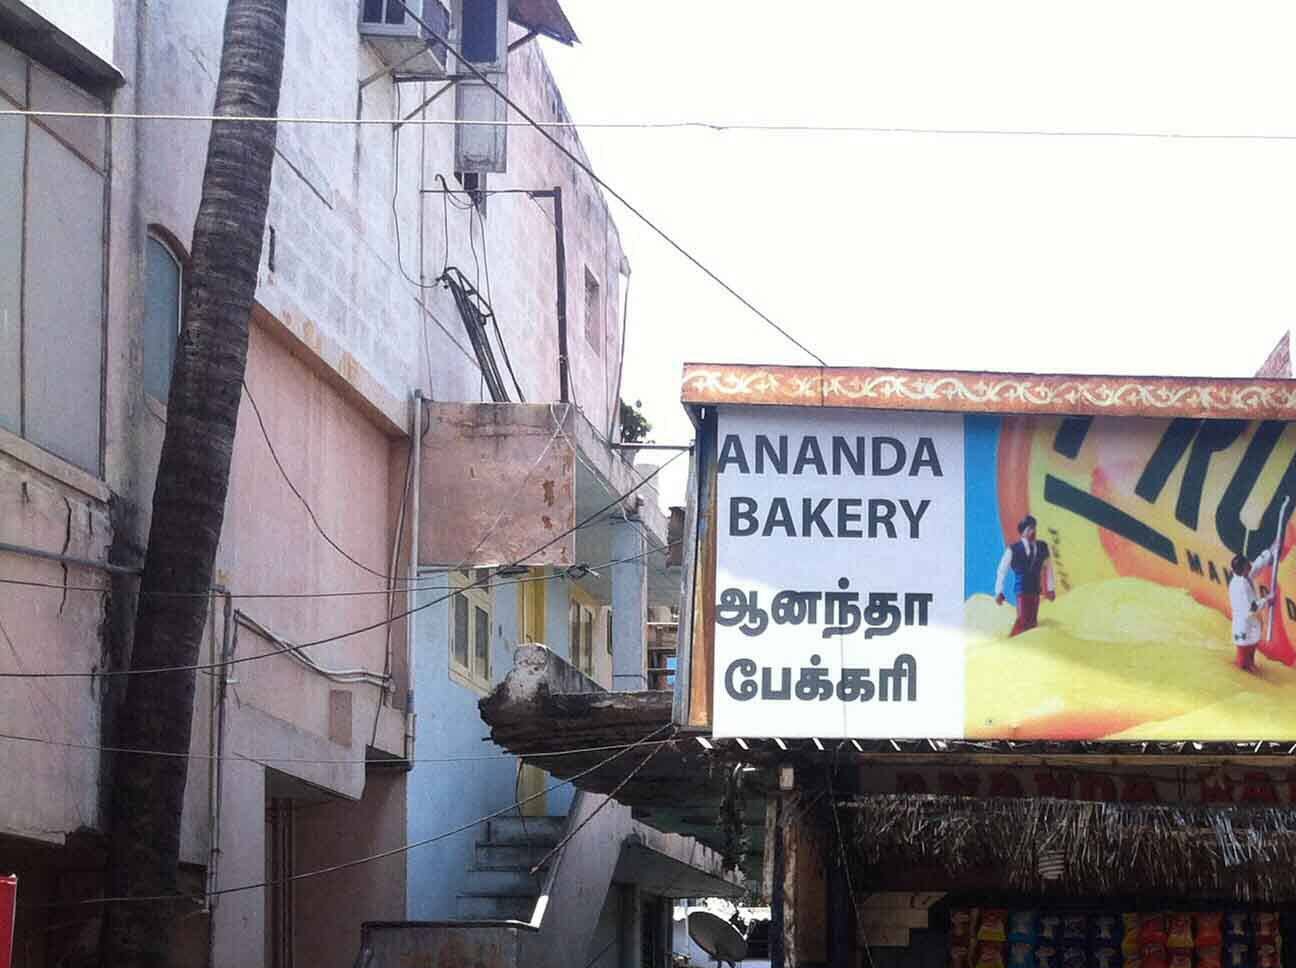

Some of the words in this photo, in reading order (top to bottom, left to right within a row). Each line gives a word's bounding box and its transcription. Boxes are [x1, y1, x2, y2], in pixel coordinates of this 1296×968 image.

[718, 434, 944, 477] ANANDA
[729, 496, 932, 539] BAKERY
[715, 577, 934, 640] ஆனந்தா
[724, 653, 917, 703] பேக்கரி
